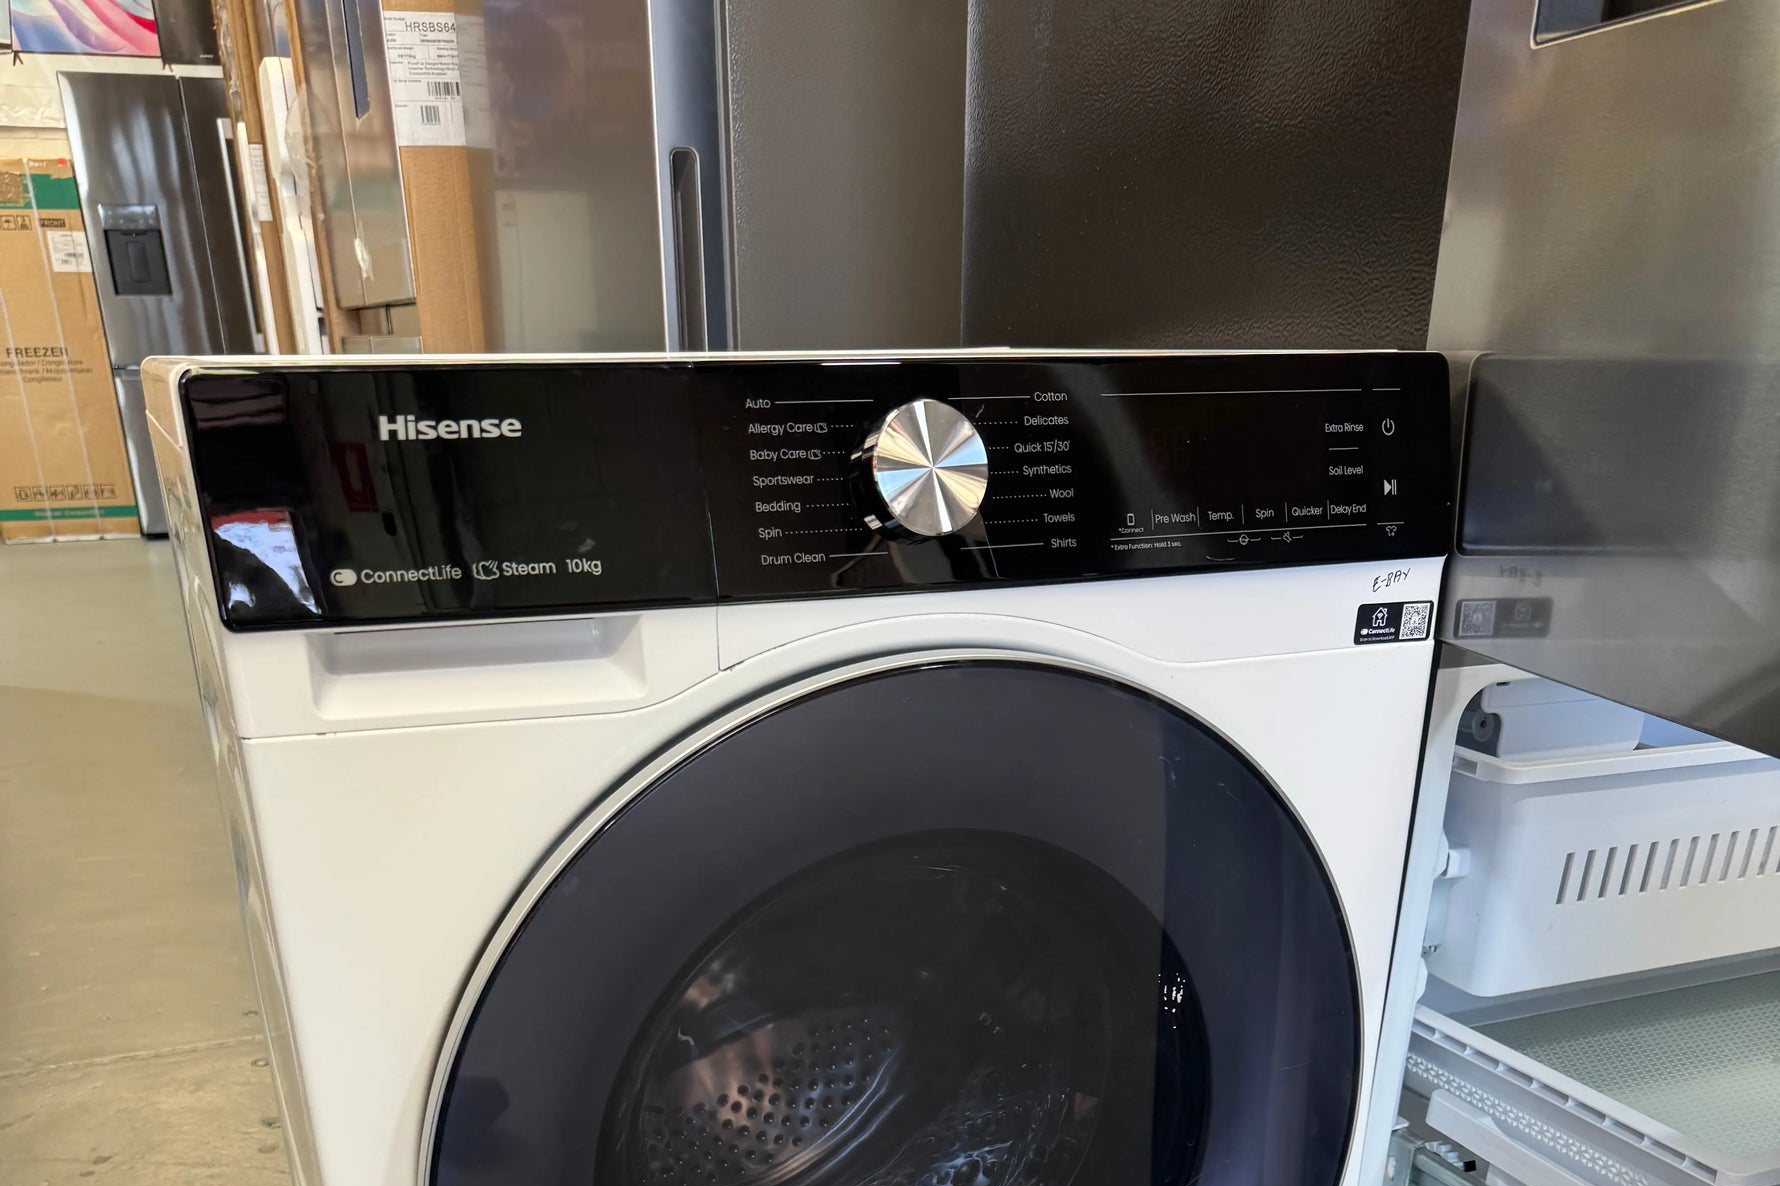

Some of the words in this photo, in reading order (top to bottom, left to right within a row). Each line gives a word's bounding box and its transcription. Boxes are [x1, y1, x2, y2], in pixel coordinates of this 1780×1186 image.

[1034, 391, 1068, 402] Cotton
[745, 398, 771, 409] Auto
[1024, 415, 1069, 426] Delicates
[378, 415, 522, 441] Hisense
[748, 423, 785, 436] Allergy
[786, 422, 813, 433] Care
[1325, 423, 1343, 433] Extra
[1344, 422, 1364, 432] Rinse
[1014, 442, 1042, 453] Quick
[750, 449, 778, 462] Baby
[780, 449, 806, 459] Care
[1022, 464, 1072, 477] Synthetics
[1328, 466, 1343, 475] Soil
[1344, 465, 1364, 475] Level
[752, 475, 814, 488] Sportswear
[1049, 488, 1074, 498] Wool
[755, 501, 801, 513] Bedding
[1291, 506, 1323, 517] Quicker
[1330, 504, 1351, 515] Delay
[1352, 503, 1367, 513] End
[1043, 512, 1075, 523] Towels
[1155, 514, 1169, 524] Pre
[1170, 512, 1196, 523] Wash
[1207, 511, 1235, 521] Temp.
[1255, 508, 1275, 520] Spin
[758, 527, 783, 540] Spin
[1051, 538, 1077, 548] Shirts
[761, 554, 792, 565] Drum
[794, 553, 826, 563] Clean
[361, 565, 462, 584] ConnectLife
[502, 559, 556, 576] Steam
[565, 558, 602, 575] 10kg
[1372, 568, 1411, 592] E-BAY
